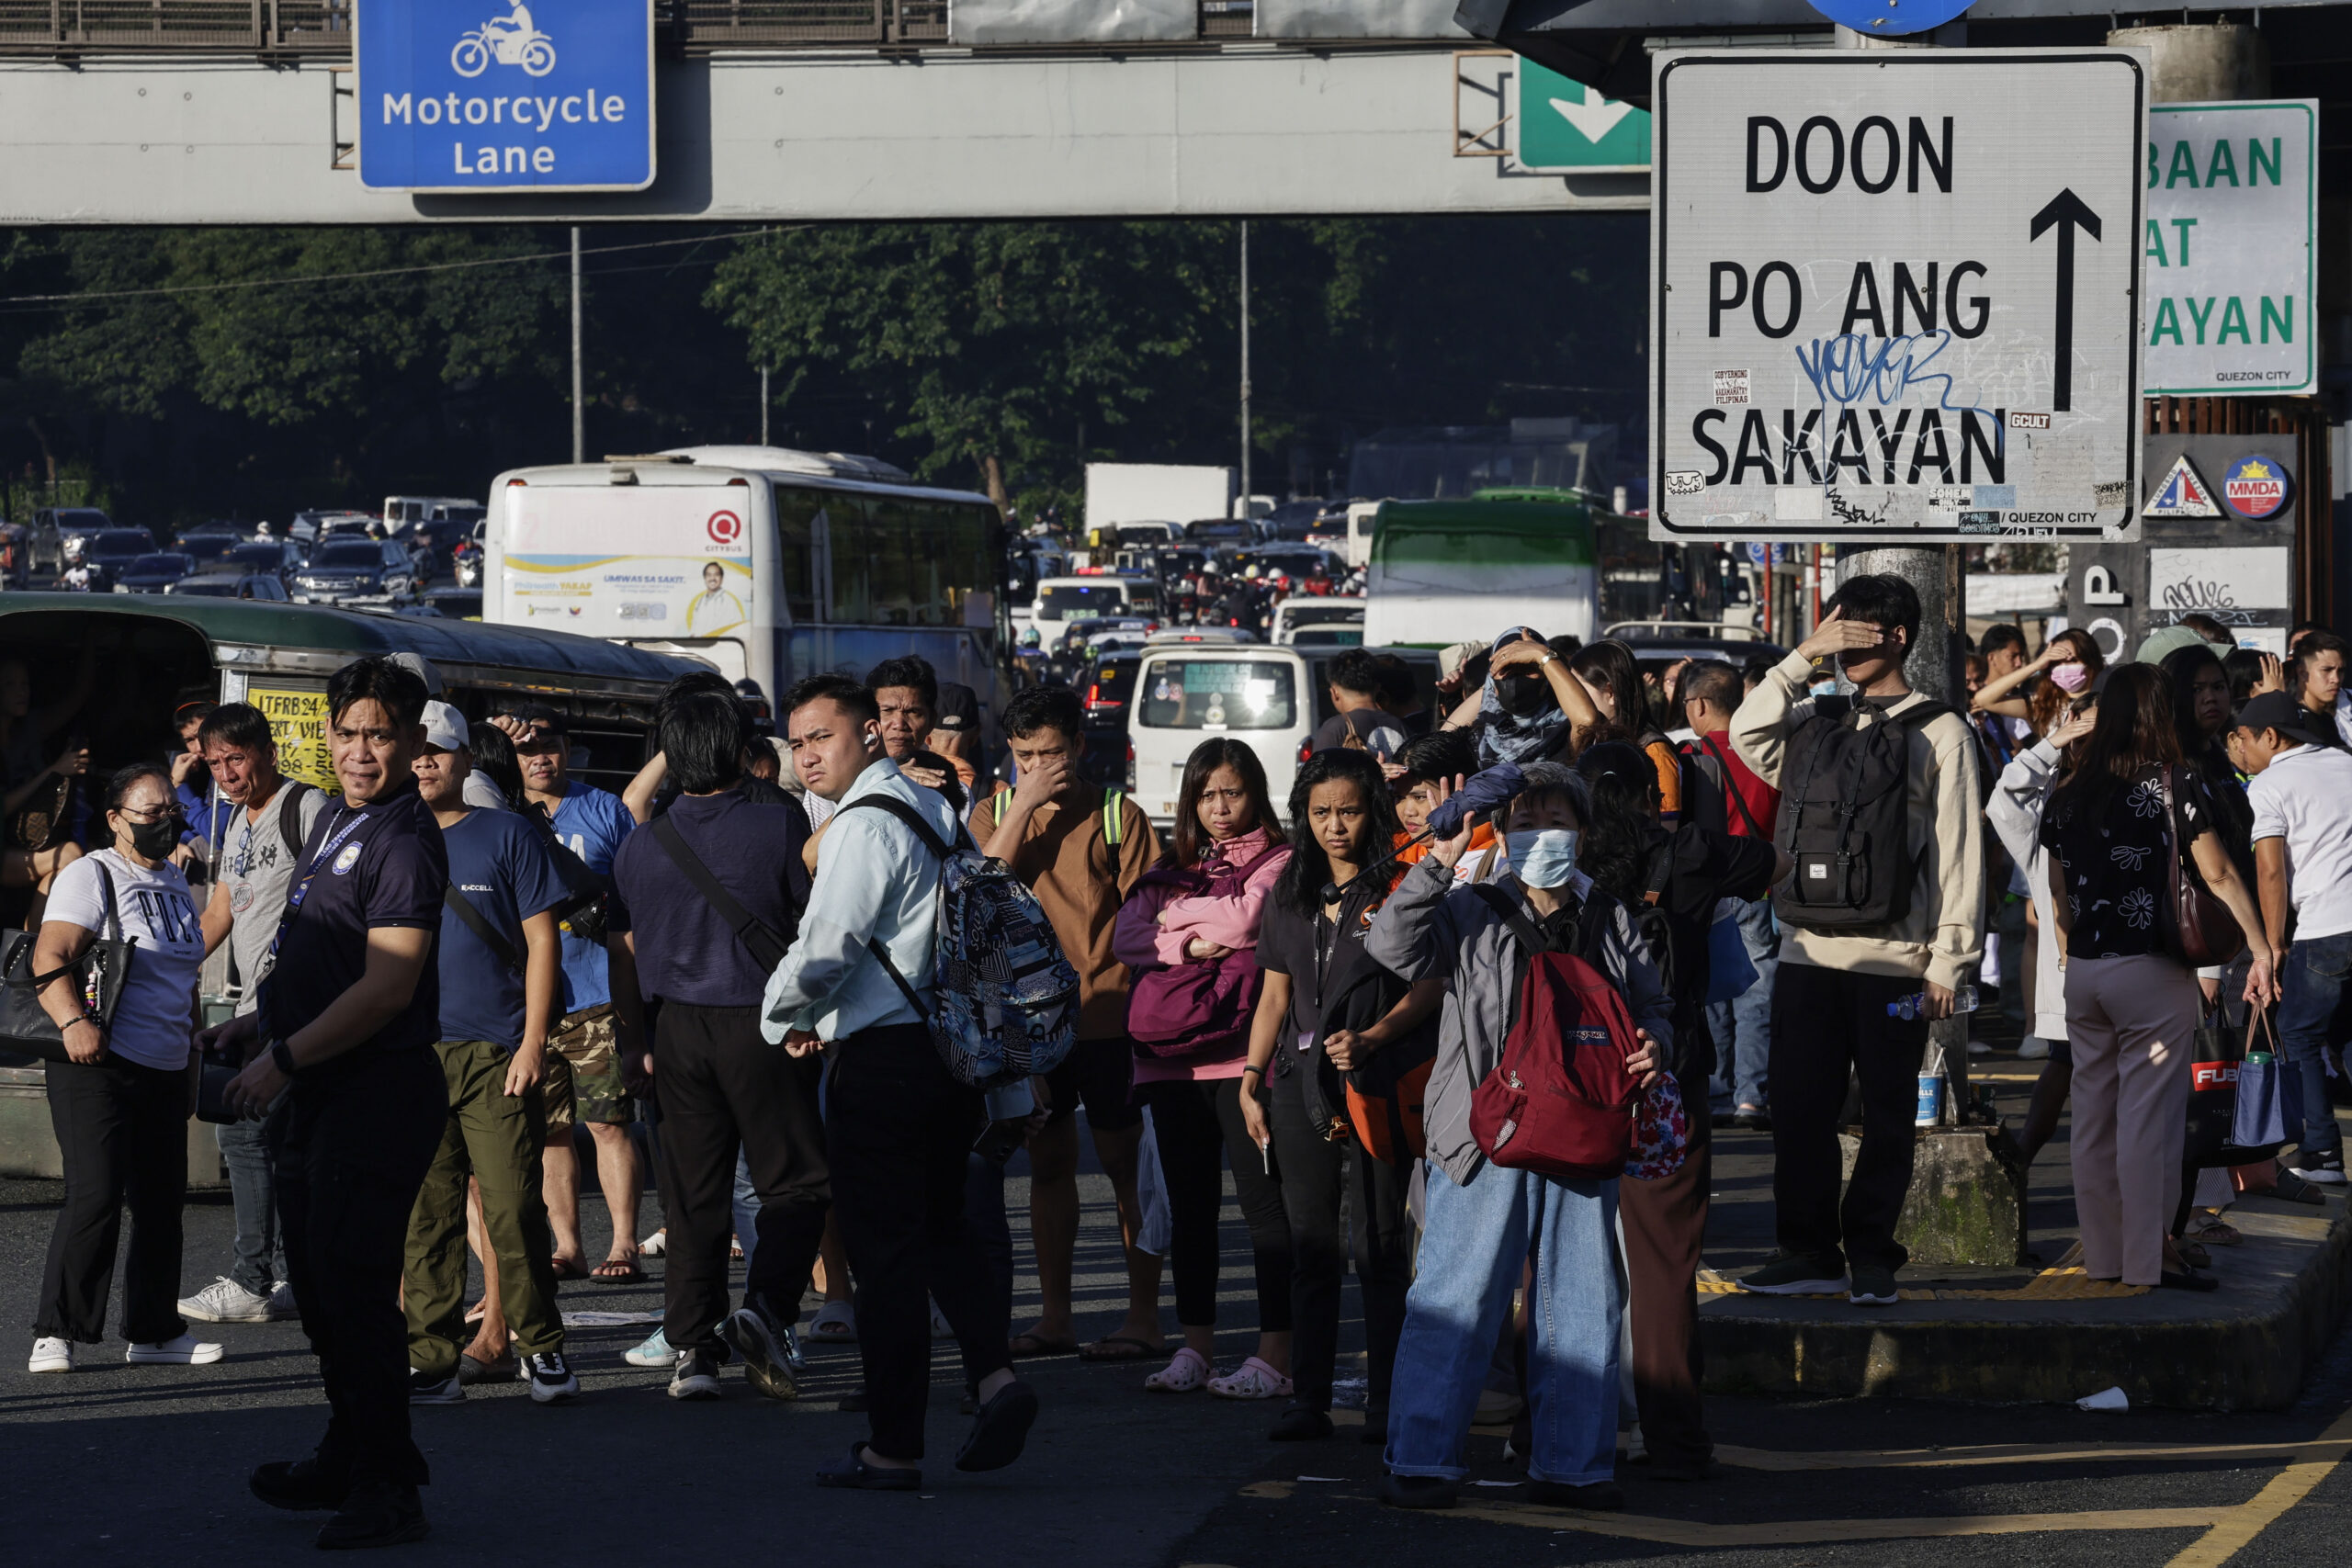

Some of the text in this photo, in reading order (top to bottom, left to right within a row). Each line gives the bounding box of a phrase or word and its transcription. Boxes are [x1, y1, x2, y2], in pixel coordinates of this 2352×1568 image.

[384, 89, 626, 132] Motorcycle
[454, 142, 555, 174] Lane
[1747, 116, 1954, 195] DOON
[1709, 260, 1991, 340] PO ANG
[2216, 370, 2291, 382] QUEZON CITY
[1715, 395, 1748, 405] FILIPINAS
[2011, 413, 2050, 429] GCULT
[1692, 408, 2006, 486] SAKAYAN
[2153, 468, 2177, 502] LUNGSOD
[2186, 468, 2208, 502] QUEZON
[2229, 481, 2280, 496] MMDA
[2008, 512, 2064, 524] QUEZON
[2067, 512, 2098, 524] CITY
[604, 574, 643, 583] UMIWAS
[644, 575, 656, 583] SA
